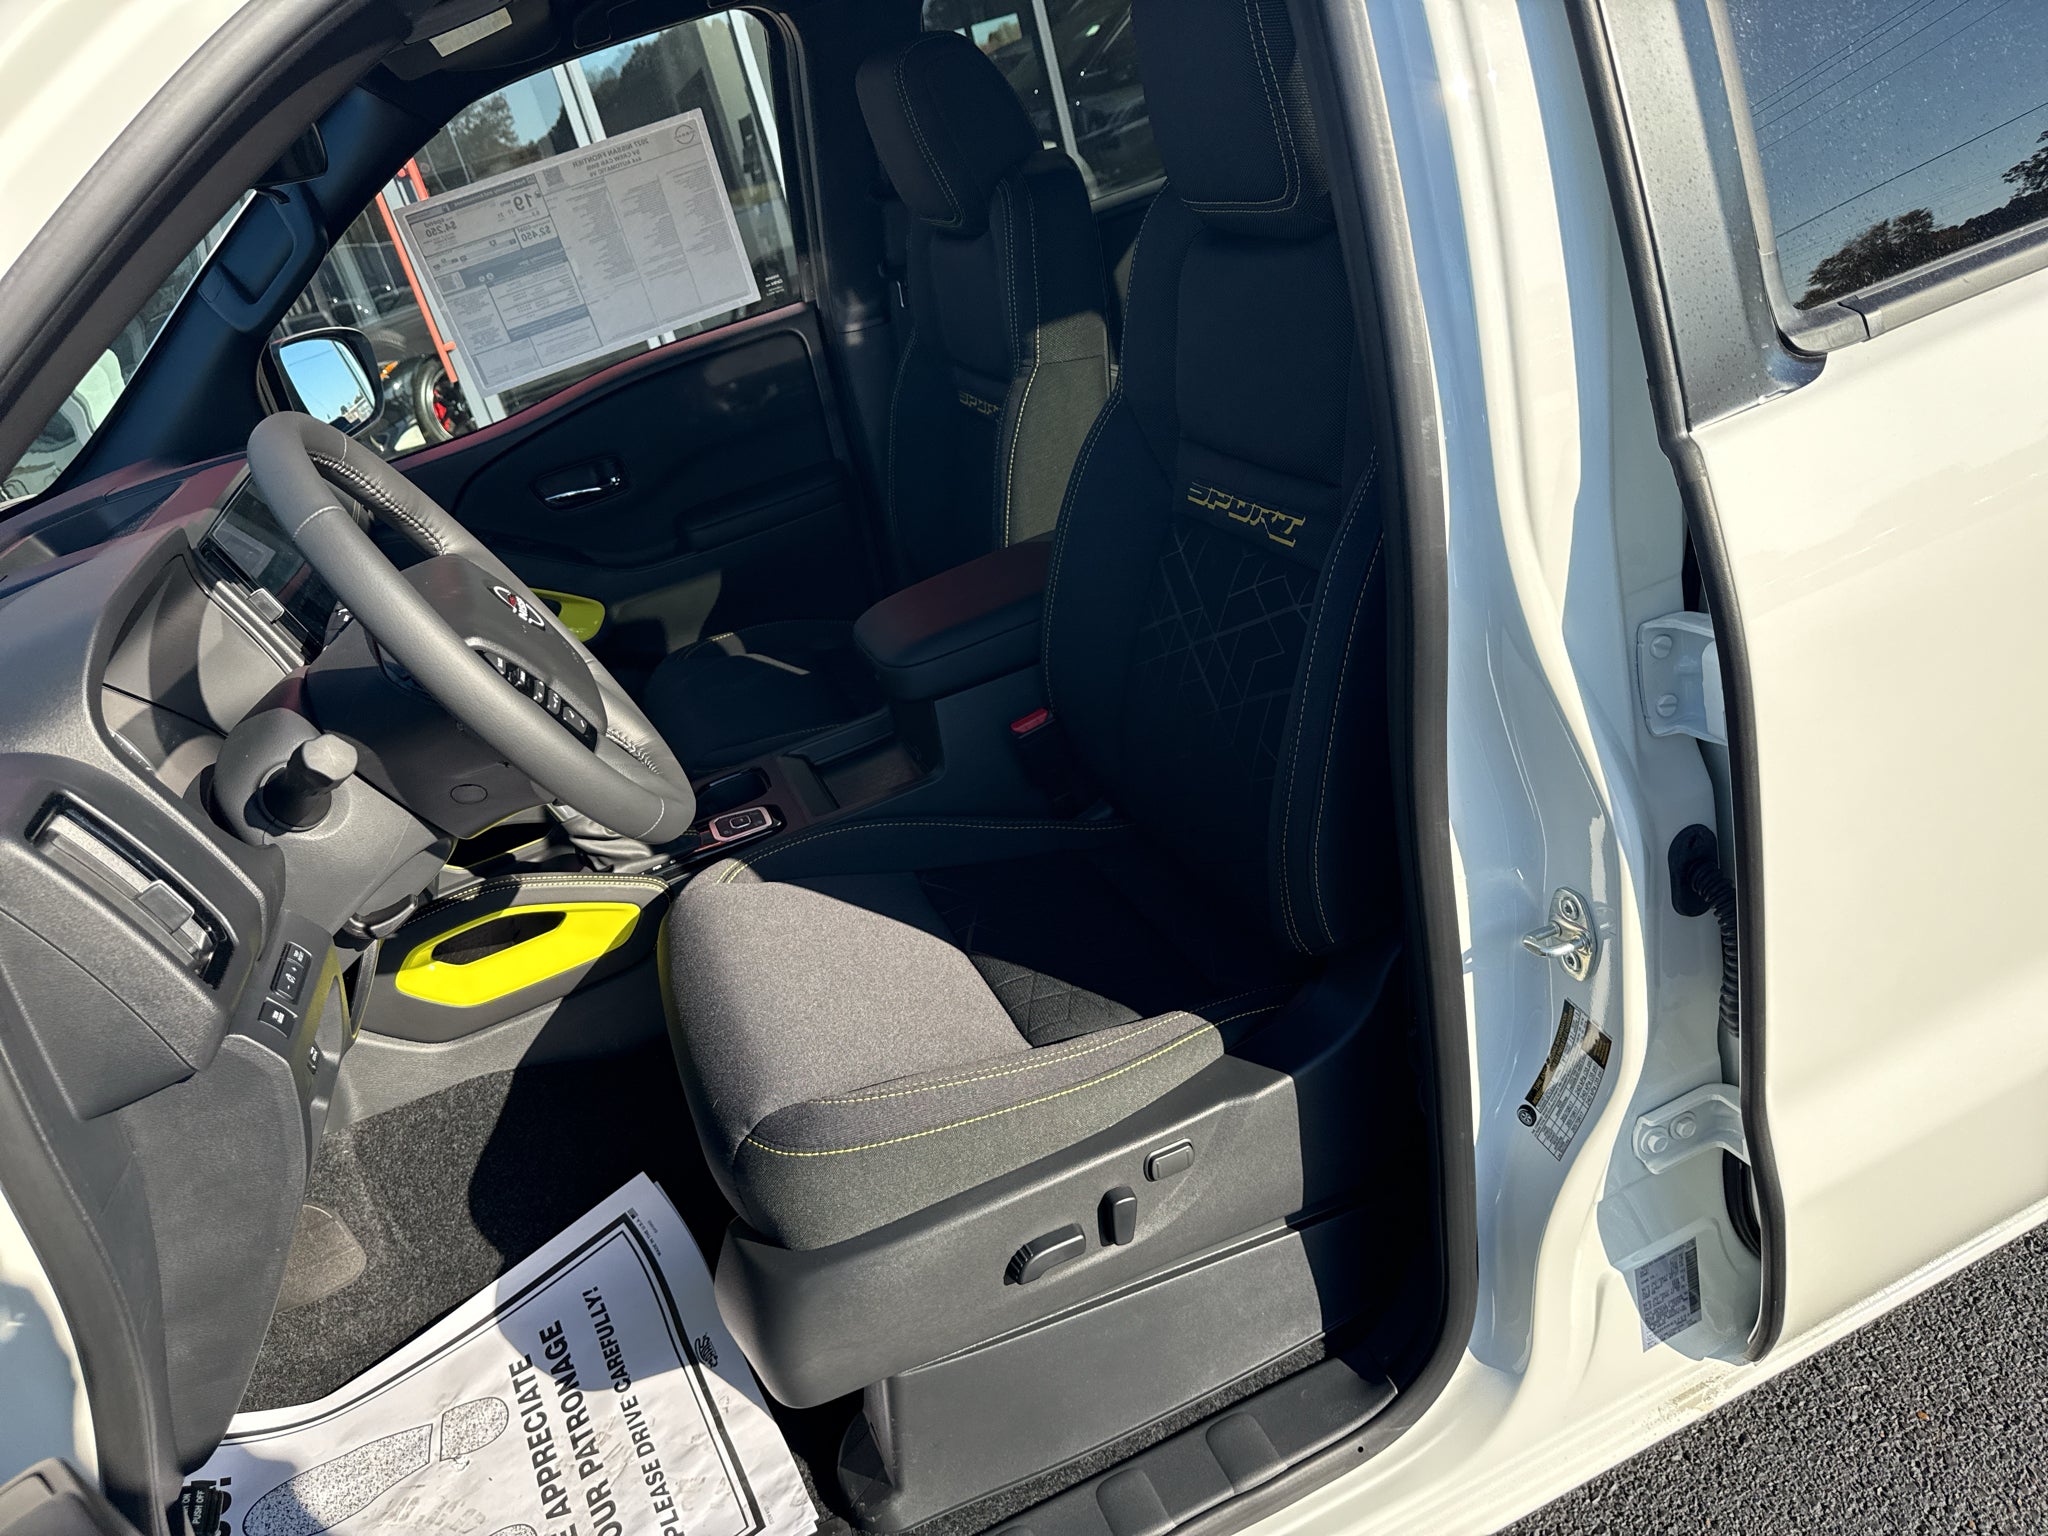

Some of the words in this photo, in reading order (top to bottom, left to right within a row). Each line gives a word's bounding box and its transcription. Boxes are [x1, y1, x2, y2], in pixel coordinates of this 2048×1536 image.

[959, 391, 1002, 423] SPOR
[582, 1286, 632, 1393] CAREFULLY!
[539, 1320, 604, 1480] PATRONAGE
[620, 1395, 655, 1460] DRIVE
[508, 1353, 572, 1520] APPRECIATE
[192, 1504, 203, 1525] PUSH
[195, 1489, 205, 1503] OFF
[641, 1458, 685, 1536] PLEASE
